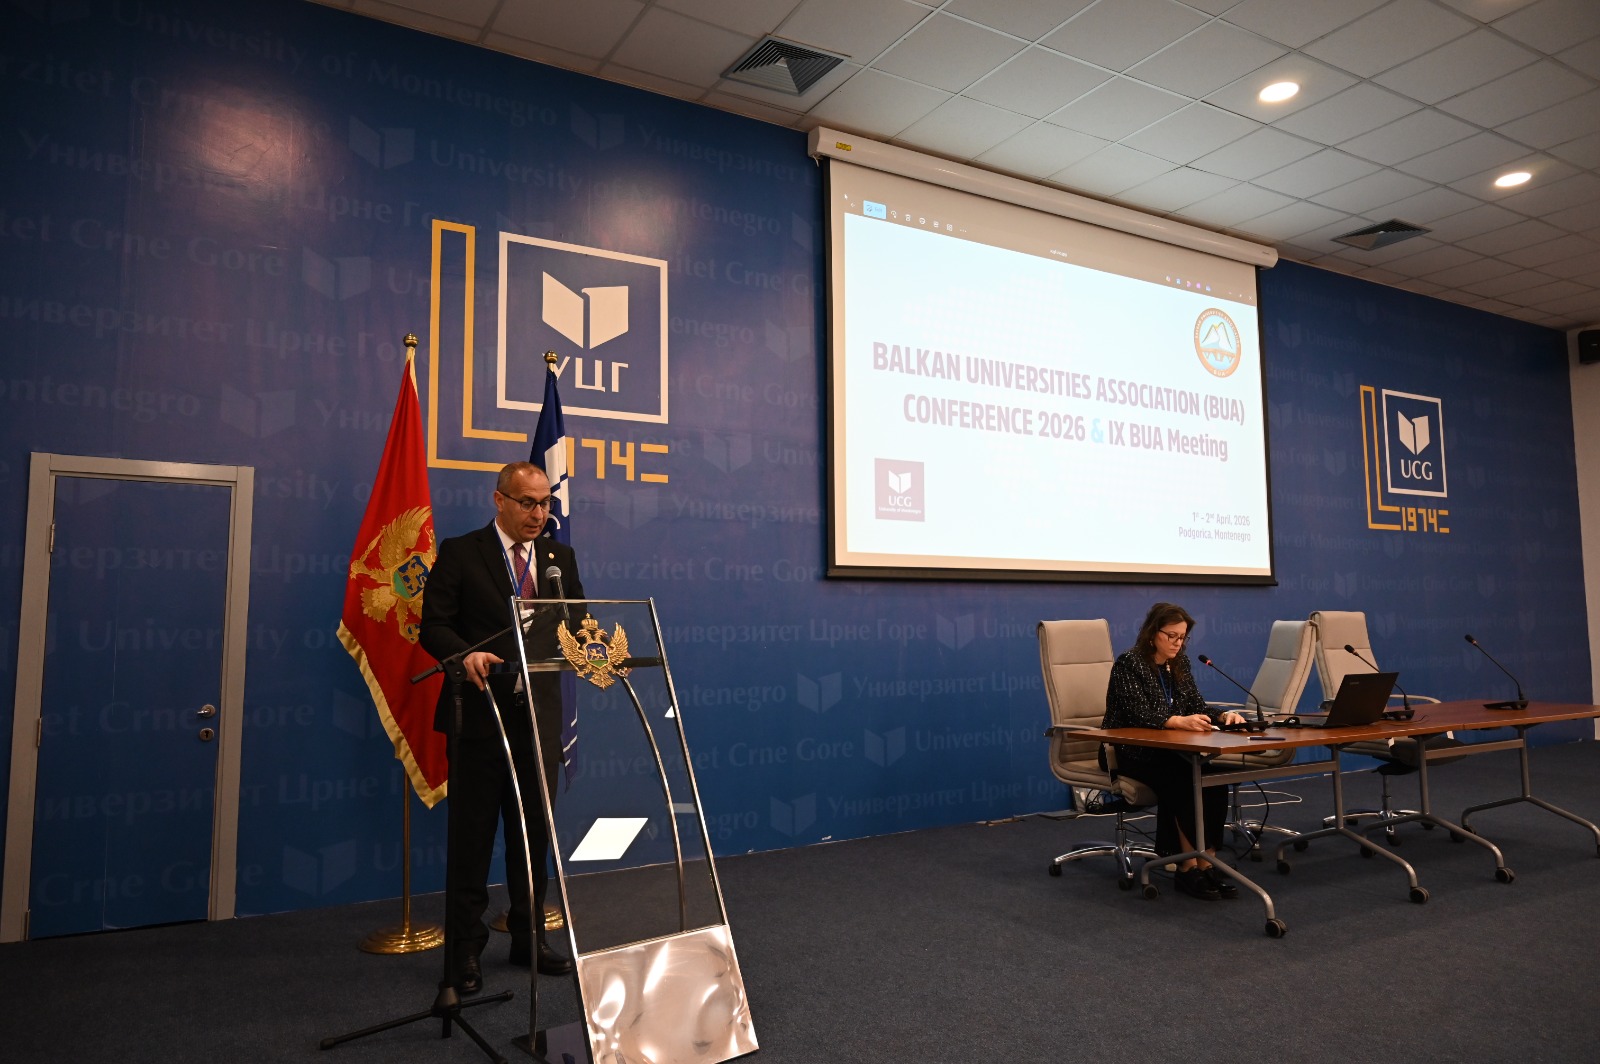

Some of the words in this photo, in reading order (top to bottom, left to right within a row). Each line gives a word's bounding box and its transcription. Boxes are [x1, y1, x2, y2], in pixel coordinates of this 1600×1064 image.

[367, 58, 557, 127] Montenegro
[430, 138, 583, 199] University
[188, 237, 285, 276] Gore
[724, 261, 784, 292] Crne
[245, 317, 346, 359] Црне
[695, 373, 755, 402] Crne
[872, 342, 961, 382] BALKAN
[966, 357, 1091, 401] UNIVERSITIES
[1095, 376, 1200, 417] ASSOCIATION
[1203, 393, 1245, 426] (BUA)
[903, 393, 1033, 436] CONFERENCE
[1038, 410, 1086, 442] 2026
[1090, 417, 1105, 445] &
[1108, 420, 1126, 446] IX
[1129, 422, 1164, 452] BUA
[1167, 429, 1229, 462] Meeting
[1400, 458, 1433, 481] UCG
[888, 495, 912, 507] UCG
[1178, 526, 1213, 541] Podgorica,
[1214, 528, 1251, 543] Montenegro
[1216, 513, 1233, 526] April,
[1234, 514, 1251, 527] 2026
[1401, 506, 1438, 533] 1974
[702, 556, 764, 582] Crne
[808, 617, 871, 649] Црне
[877, 618, 928, 648] Горе
[852, 674, 988, 703] Универзитет
[990, 670, 1042, 698] Црне
[728, 741, 788, 768] Crne
[795, 737, 855, 762] Gore
[914, 725, 1013, 752] University
[1020, 721, 1039, 744] of
[278, 773, 380, 812] Црне
[827, 787, 966, 819] Универзитет
[970, 780, 1023, 801] Црне
[35, 871, 145, 906] Crne
